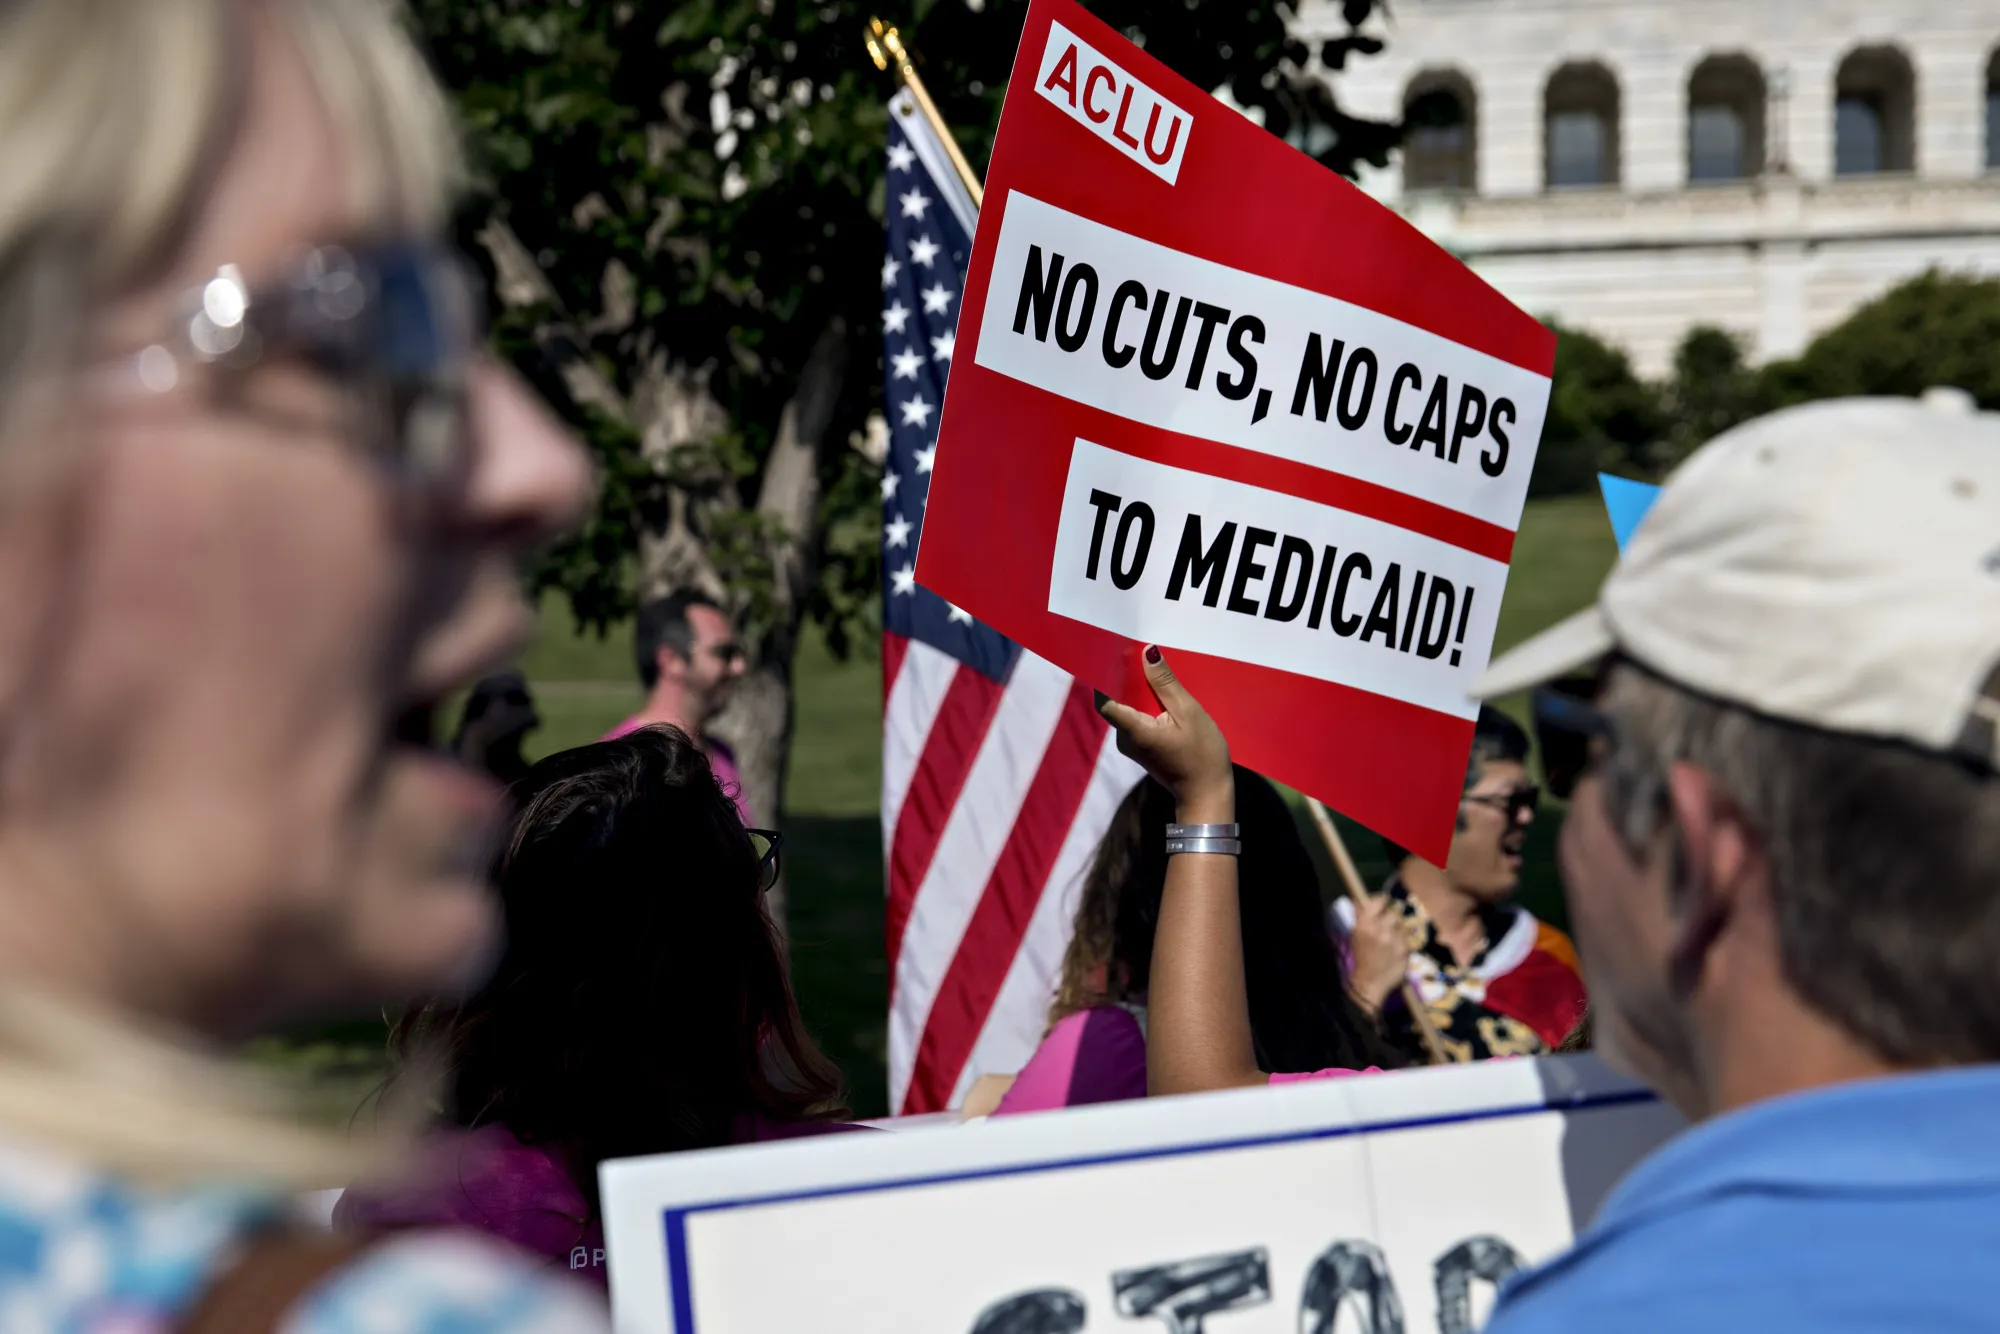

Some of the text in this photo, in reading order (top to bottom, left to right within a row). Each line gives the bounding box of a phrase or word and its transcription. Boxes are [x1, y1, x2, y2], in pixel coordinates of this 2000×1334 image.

[1044, 42, 1182, 166] ACLU
[1012, 243, 1517, 478] NO CUTS, NO CAPS
[1085, 487, 1476, 667] TO MEDICAID!
